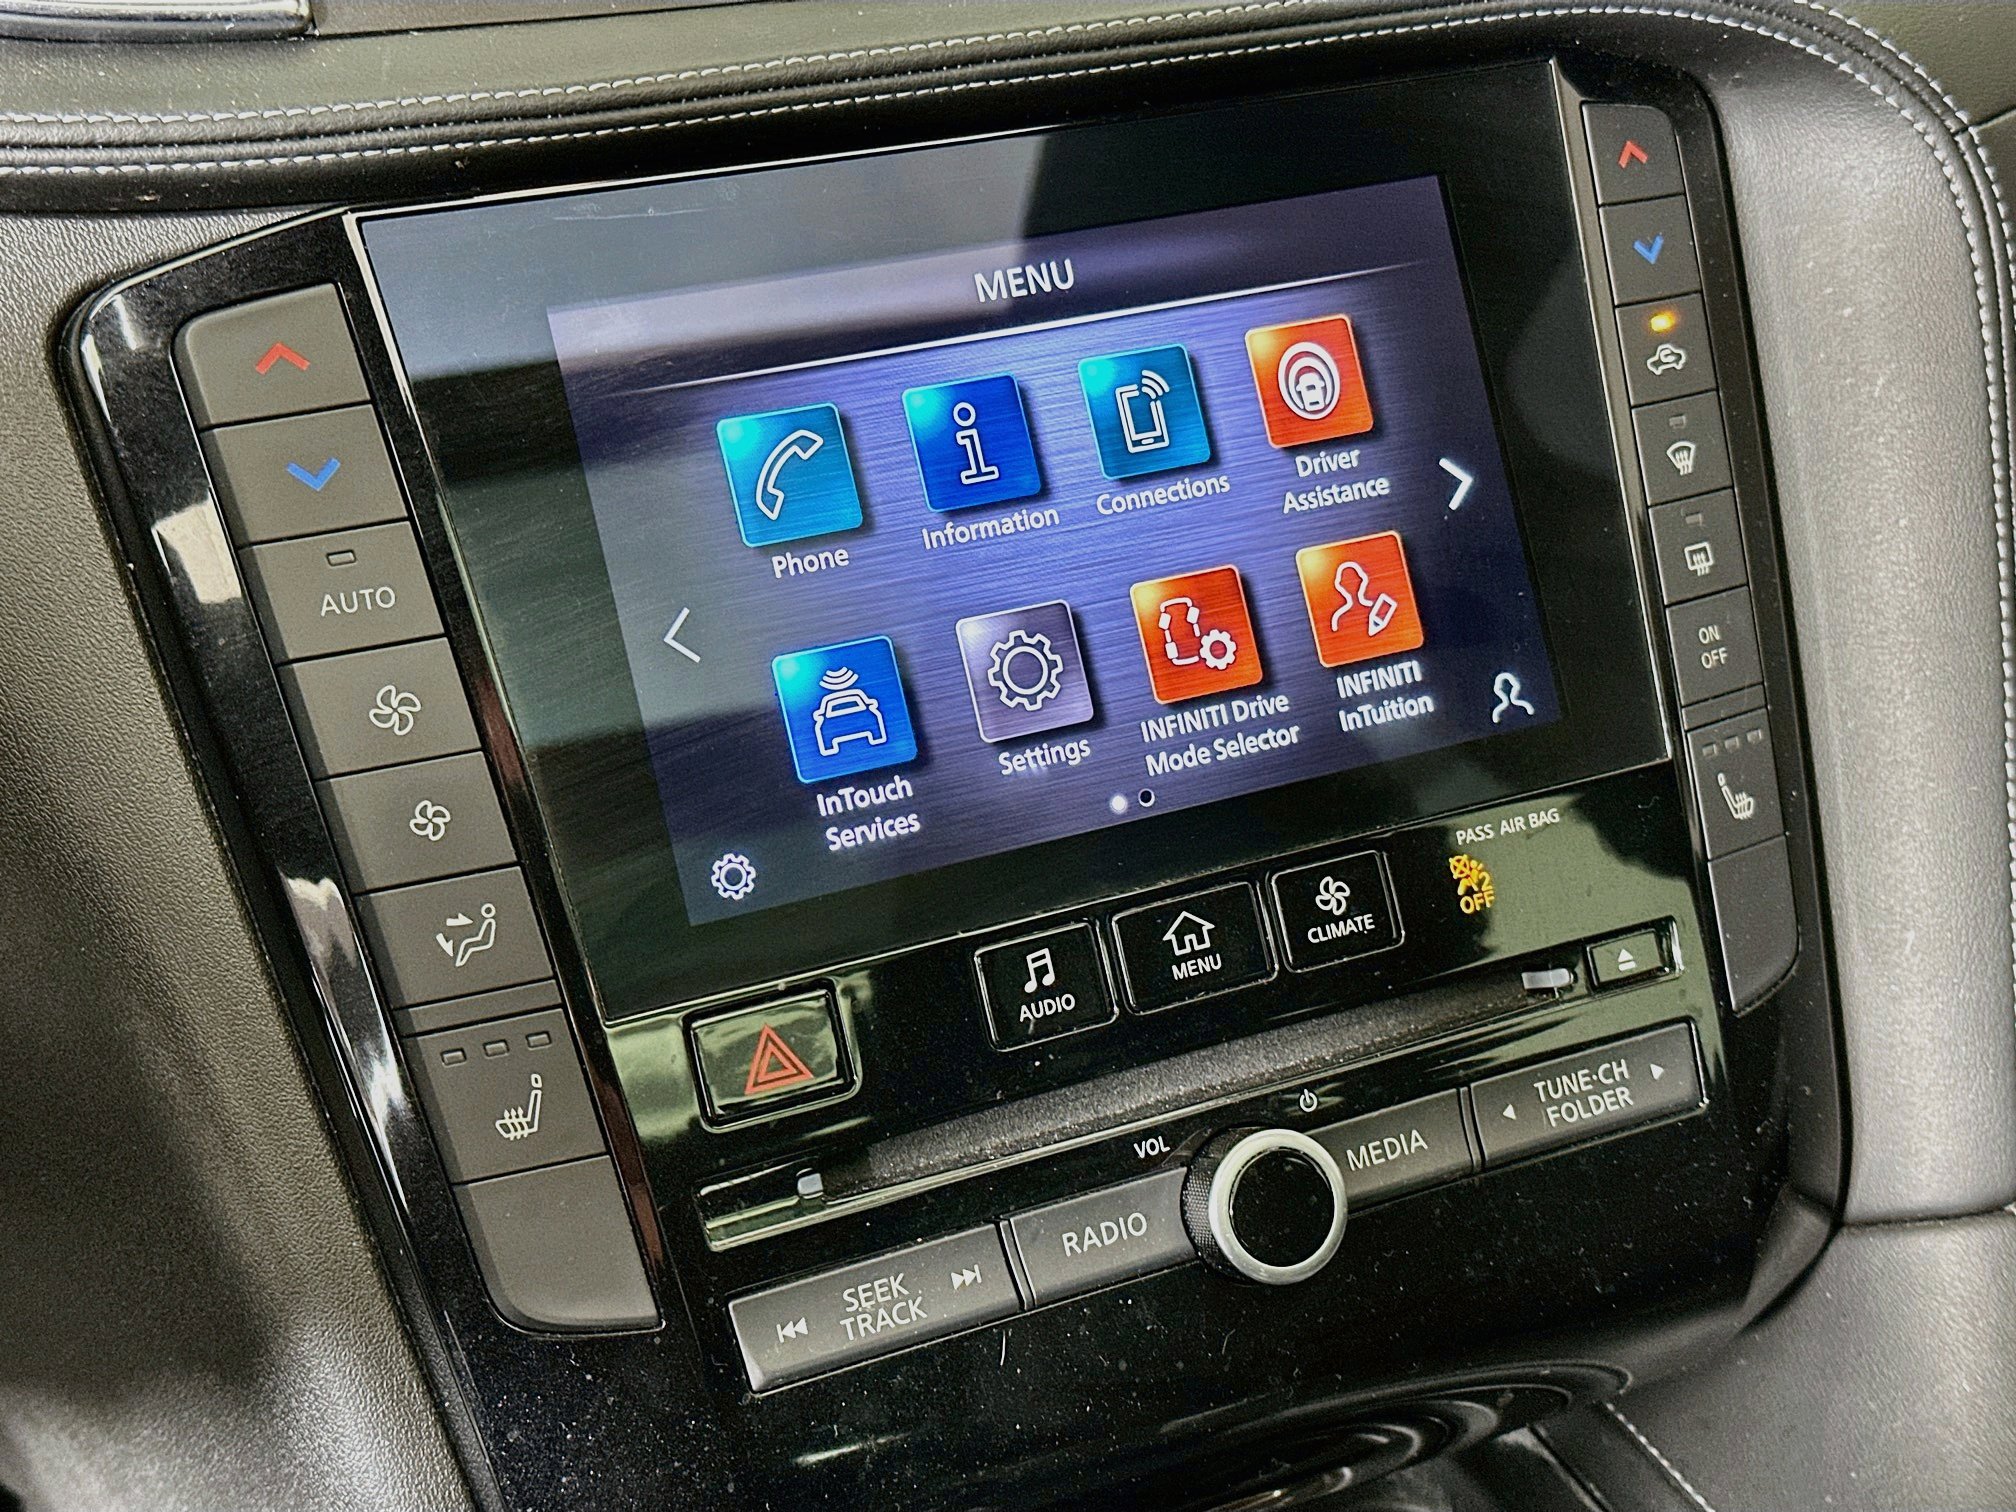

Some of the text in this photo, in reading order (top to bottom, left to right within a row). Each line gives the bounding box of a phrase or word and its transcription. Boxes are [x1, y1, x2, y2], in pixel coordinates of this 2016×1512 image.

[974, 258, 1075, 303] MENU
[1295, 446, 1361, 478] Driver
[1096, 472, 1231, 516] Connections
[1282, 475, 1391, 515] Assistance
[922, 504, 1060, 550] Information
[771, 545, 850, 580] Phone
[320, 586, 397, 617] AUTO
[1699, 625, 1721, 644] ON
[1701, 646, 1728, 670] OFF
[1337, 660, 1422, 699] INFINITI
[1140, 691, 1290, 744] INFINITI Drive
[1339, 693, 1434, 734] InTuition
[998, 739, 1092, 777] Settings
[1145, 724, 1301, 777] Mode Selector
[816, 776, 913, 818] InTouch
[825, 810, 920, 853] Services
[1456, 807, 1560, 846] PASS AIR BAG
[1459, 890, 1496, 914] OFF
[1307, 912, 1375, 945] CLIMATE
[1172, 954, 1222, 980] MENU
[1018, 993, 1076, 1023] AUDIO
[1546, 1087, 1633, 1127] FOLDER
[1134, 1136, 1170, 1159] VOL
[1346, 1129, 1428, 1171] MEDIA
[1061, 1212, 1148, 1257] RADIO
[842, 1273, 910, 1313] SEEK
[841, 1297, 927, 1342] TRACK
